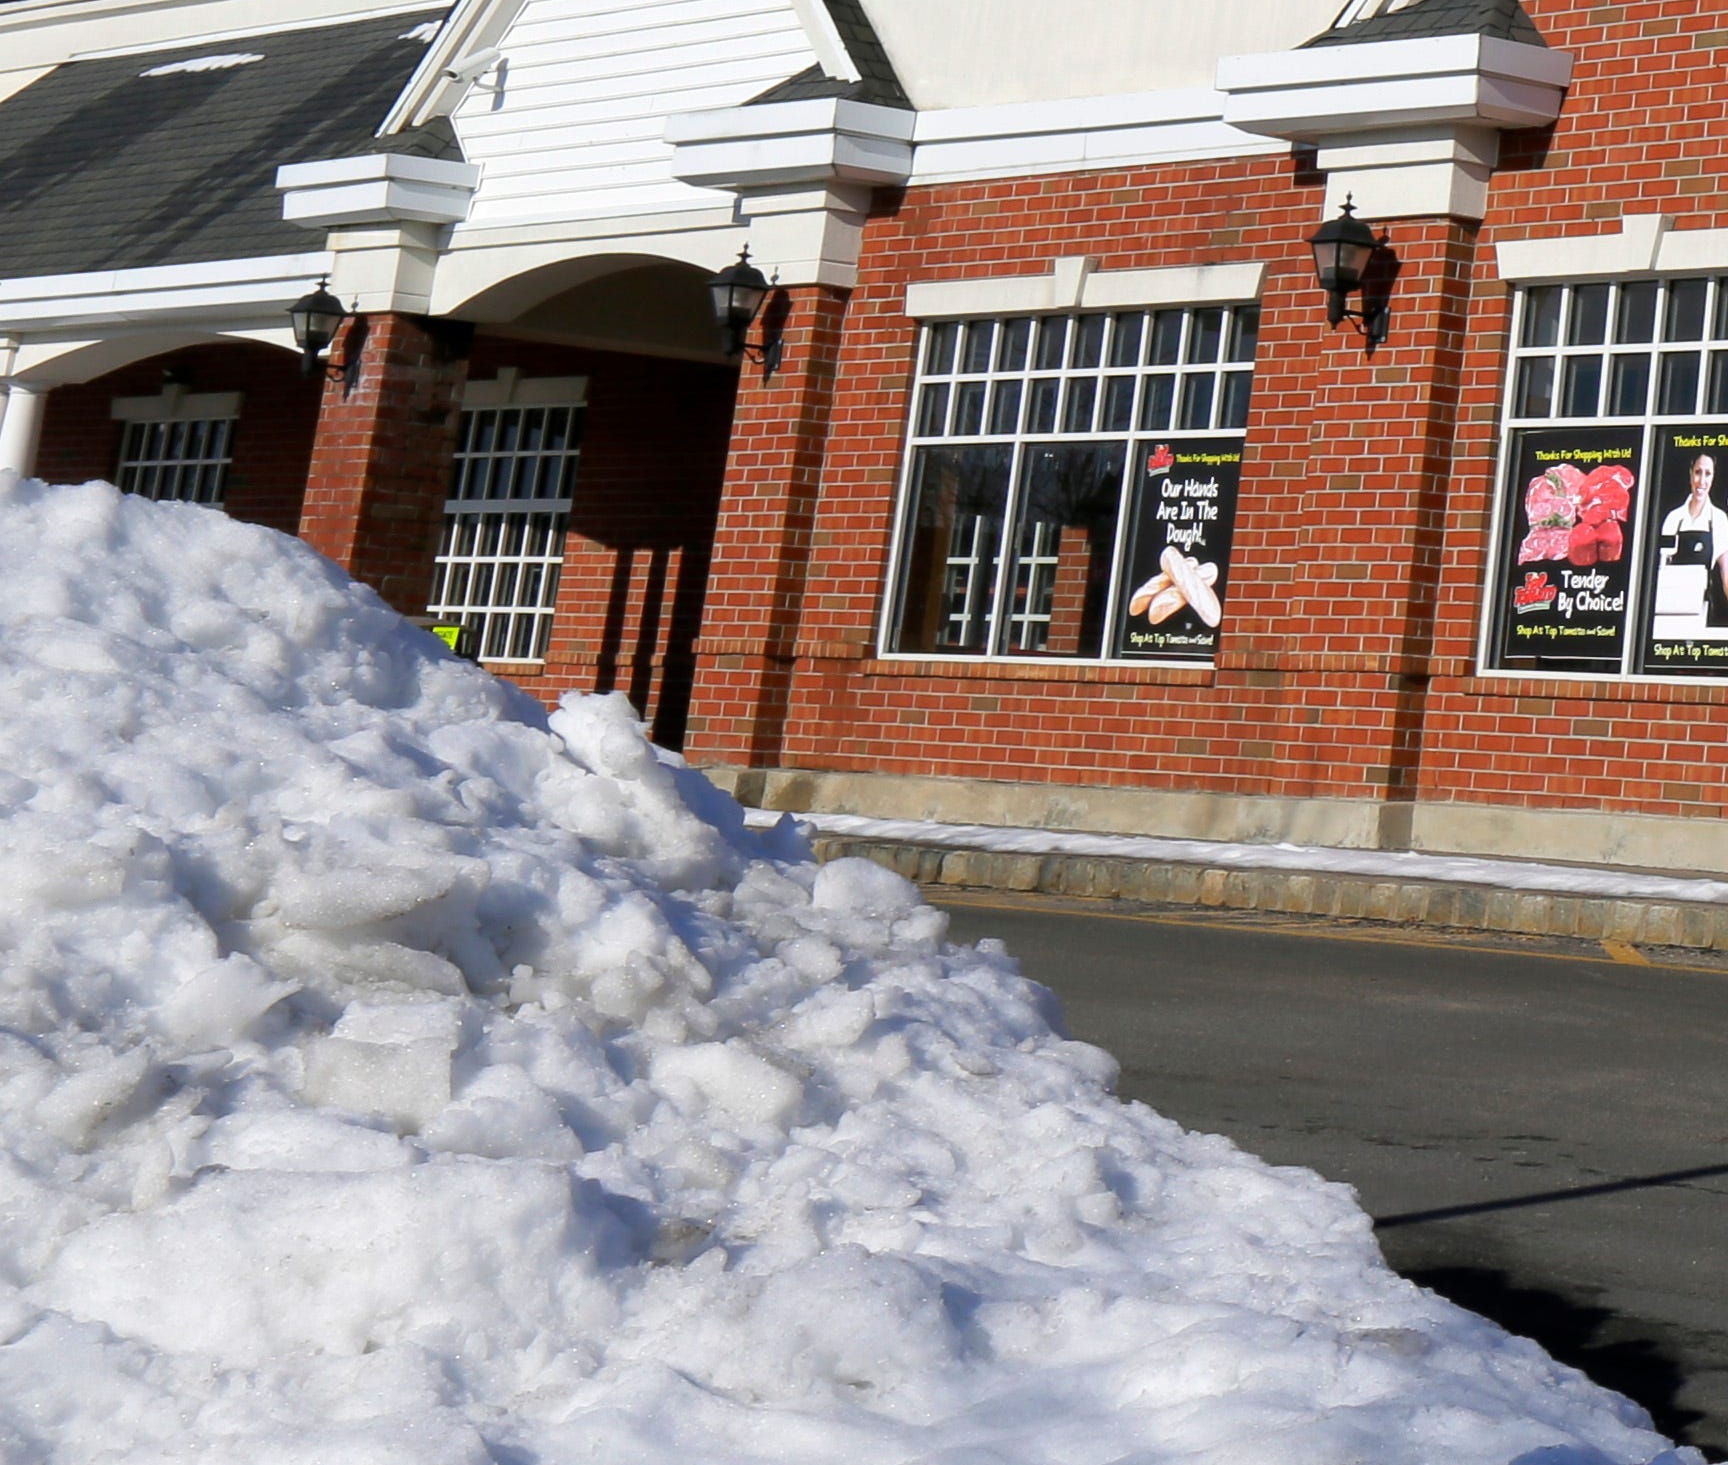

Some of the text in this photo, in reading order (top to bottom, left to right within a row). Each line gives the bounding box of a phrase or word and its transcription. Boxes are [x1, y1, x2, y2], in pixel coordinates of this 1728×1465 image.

[1673, 436, 1701, 447] Thanks
[1703, 436, 1716, 446] For
[1561, 450, 1572, 459] For
[1162, 477, 1219, 497] Our Hands
[1156, 500, 1218, 520] Are In The
[1166, 522, 1203, 551] Dough!
[1561, 568, 1609, 594] Tender
[1558, 592, 1574, 618] By
[1576, 590, 1624, 611] Choice!
[1517, 625, 1532, 639] Shop
[1532, 625, 1543, 635] At
[1544, 625, 1557, 639] Top
[1558, 626, 1586, 635] Tomato
[1654, 644, 1672, 660] Shop
[1673, 644, 1685, 656] At
[1686, 645, 1701, 661] Top
